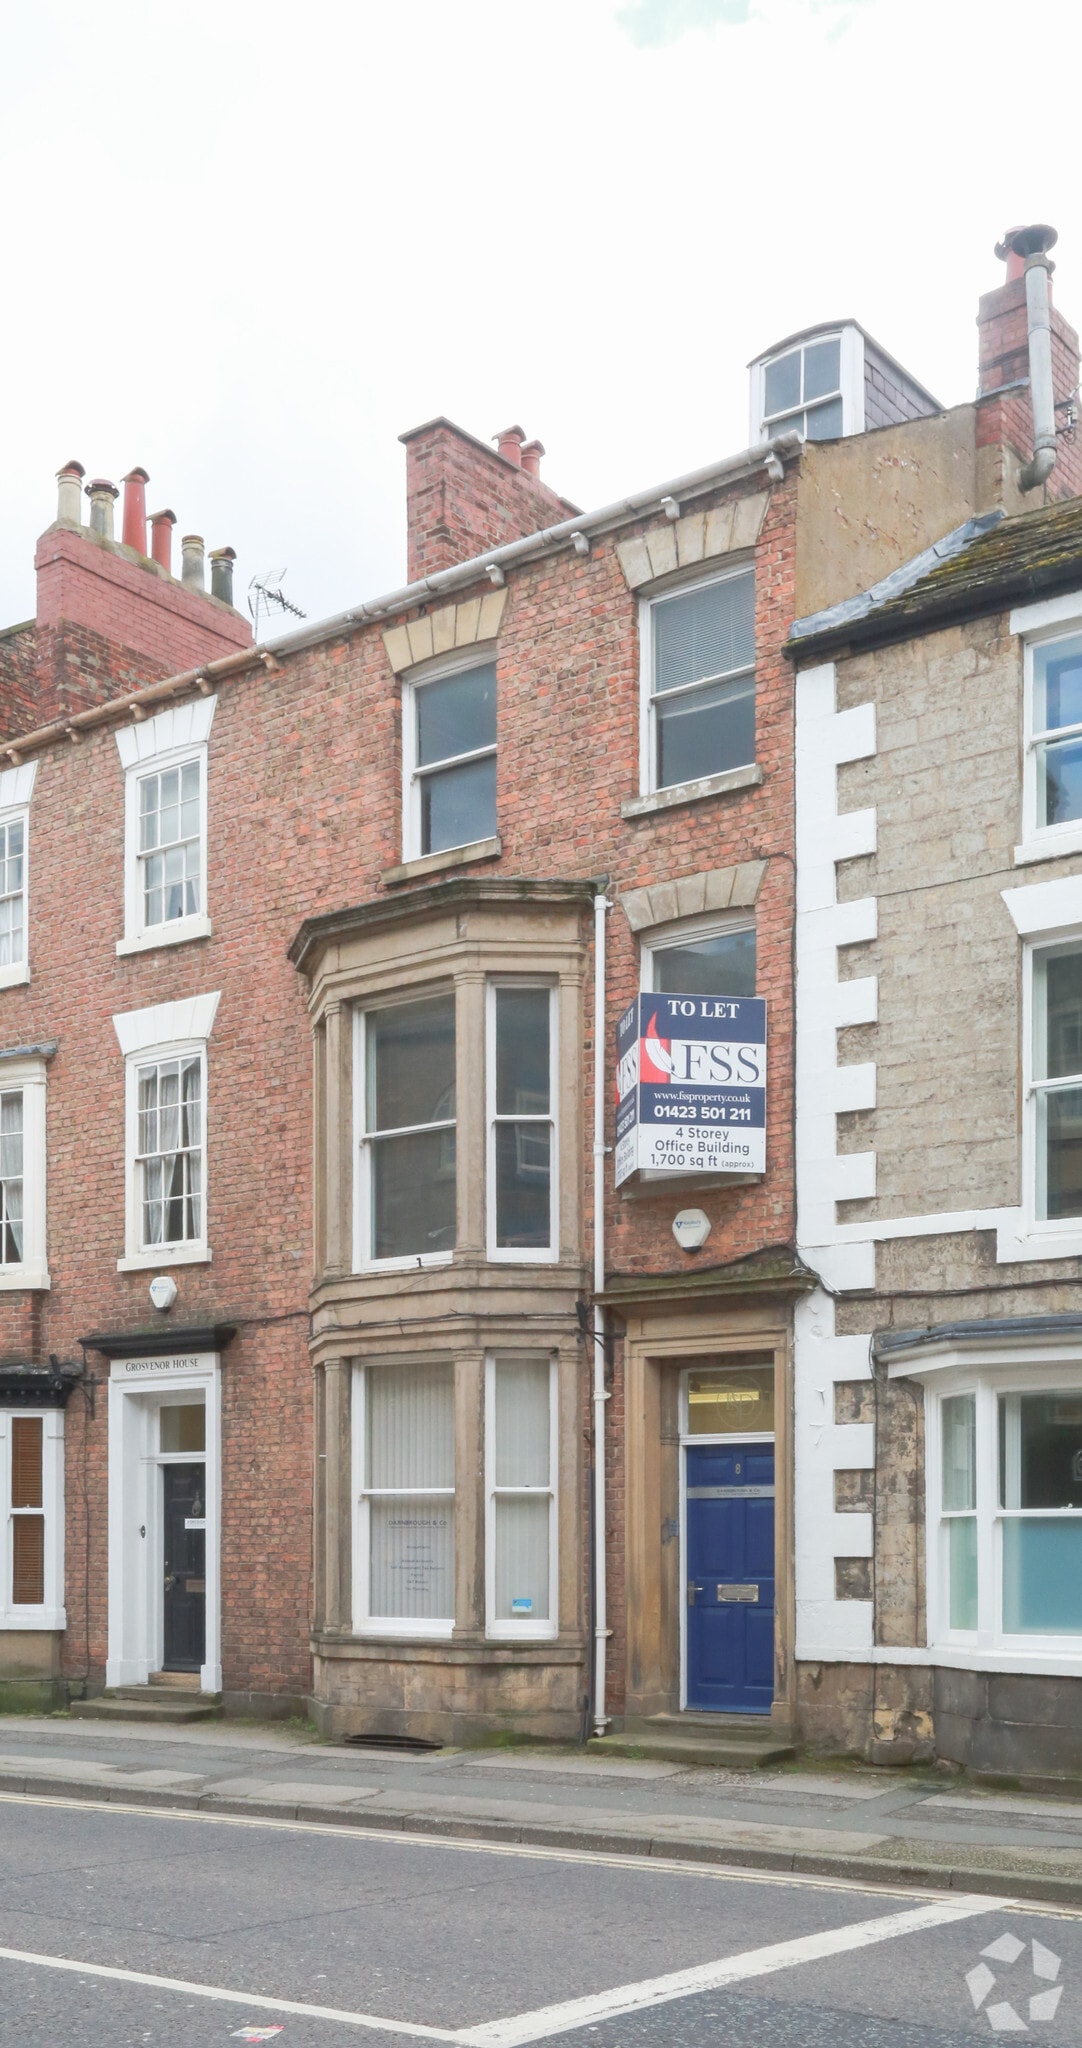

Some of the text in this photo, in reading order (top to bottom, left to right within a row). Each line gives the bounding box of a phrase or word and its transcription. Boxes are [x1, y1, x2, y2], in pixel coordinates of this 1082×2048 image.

[667, 1000, 740, 1019] TO LET
[679, 1044, 760, 1083] FSS
[653, 1091, 751, 1104] www.fssproperty.co.uk
[653, 1105, 751, 1121] 01423 501 211
[675, 1127, 729, 1141] 4 Storey
[655, 1140, 750, 1156] Office Building
[650, 1153, 754, 1169] 1,700 sq ft (approx)
[125, 1358, 199, 1372] GROSVENOR HOUSE
